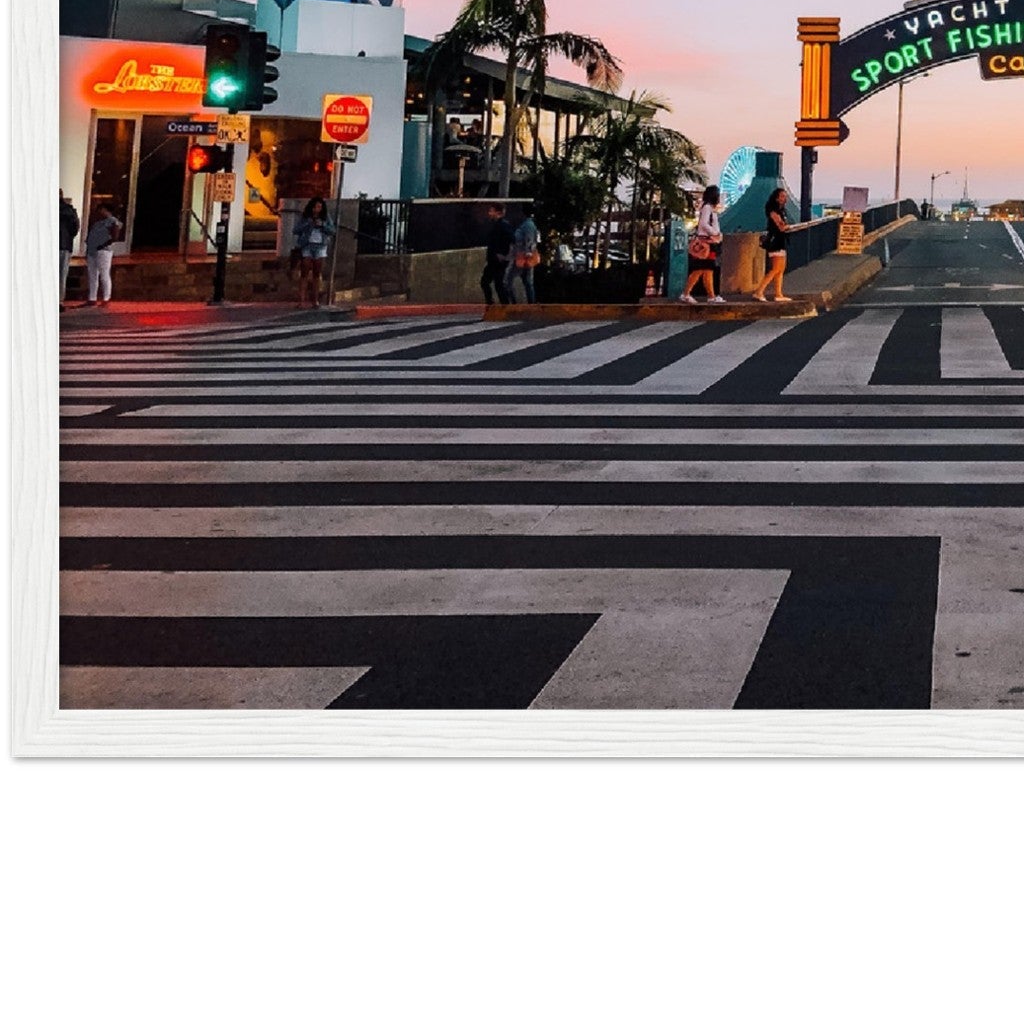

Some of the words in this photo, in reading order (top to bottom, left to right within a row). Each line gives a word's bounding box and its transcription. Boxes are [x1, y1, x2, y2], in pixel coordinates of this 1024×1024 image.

[851, 37, 933, 92] SPORT
[150, 64, 175, 76] THE
[331, 104, 344, 114] DO
[347, 105, 366, 114] NOT
[168, 122, 203, 132] Ocean
[332, 124, 359, 134] ENTER
